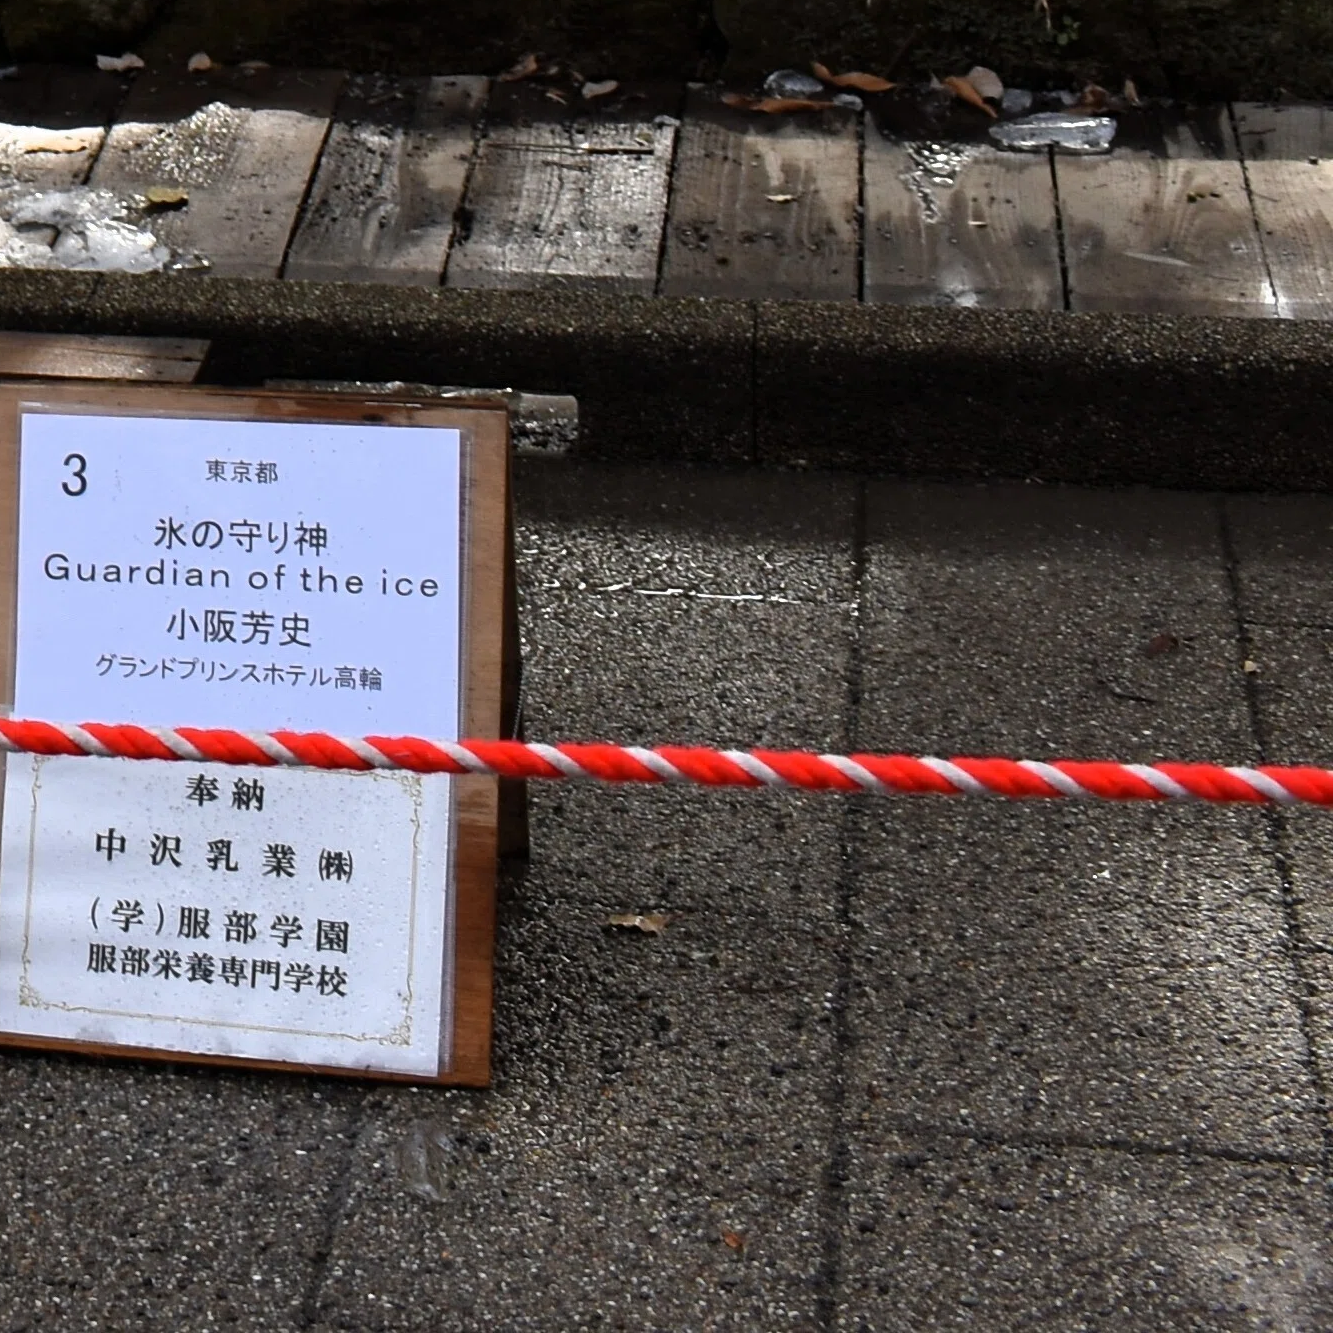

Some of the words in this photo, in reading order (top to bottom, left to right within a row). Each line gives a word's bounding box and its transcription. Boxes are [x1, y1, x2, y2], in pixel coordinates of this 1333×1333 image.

[61, 453, 88, 497] 3
[205, 458, 279, 485] 東京都
[153, 516, 328, 558] 氷の守り神
[44, 553, 230, 589] Guardian
[248, 563, 287, 591] of
[299, 565, 364, 595] the
[381, 568, 439, 598] ice
[166, 607, 312, 648] 小阪芳史
[95, 653, 383, 692] グランドプリンスホテル高輪
[185, 773, 266, 813] 奉納
[86, 942, 348, 998] 服部栄養専門学校
